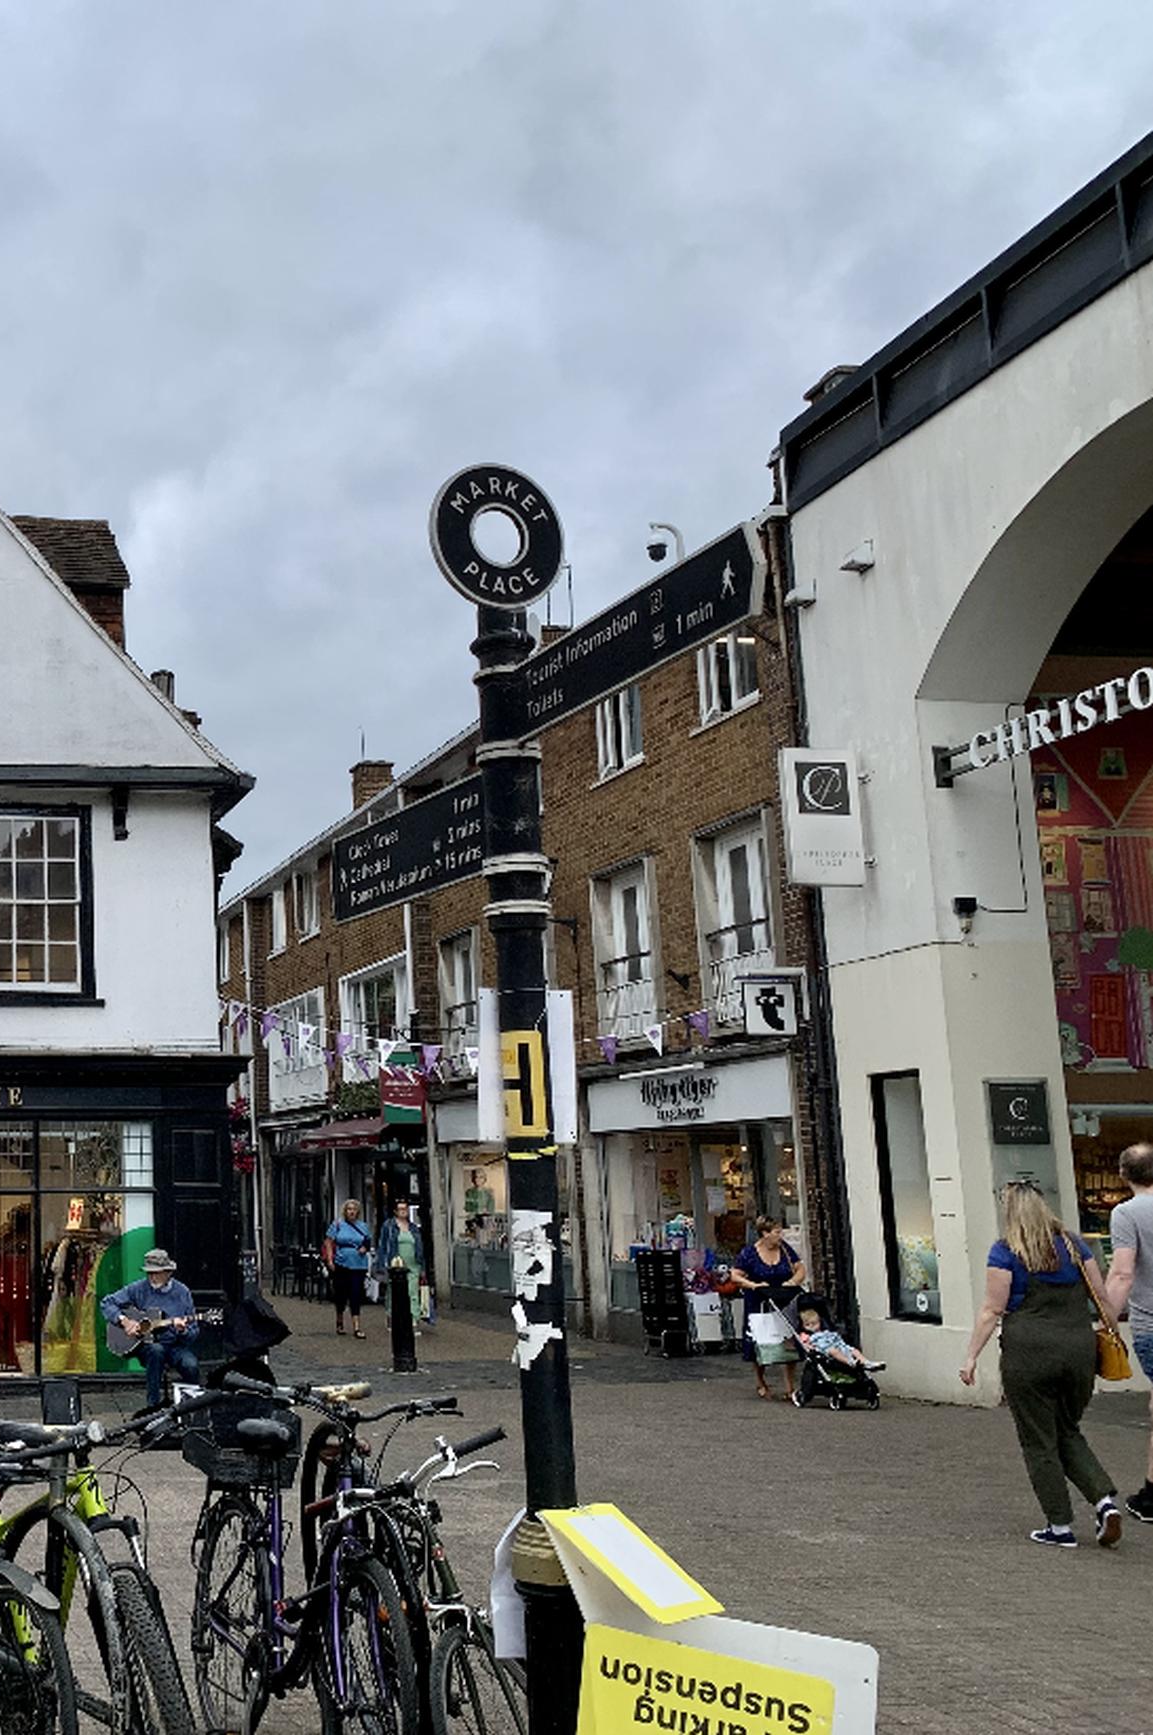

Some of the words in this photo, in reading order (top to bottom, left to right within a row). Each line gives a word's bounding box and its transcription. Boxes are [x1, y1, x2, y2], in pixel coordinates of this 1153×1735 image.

[450, 476, 548, 521] MARKET
[463, 561, 540, 594] PLACE
[676, 613, 683, 635] 1
[686, 601, 715, 631] min
[525, 652, 564, 690] Tourist
[565, 609, 638, 666] Information
[969, 667, 1153, 769] CHRISTO
[600, 1655, 813, 1735] Suspension
[634, 1695, 772, 1735] arking
